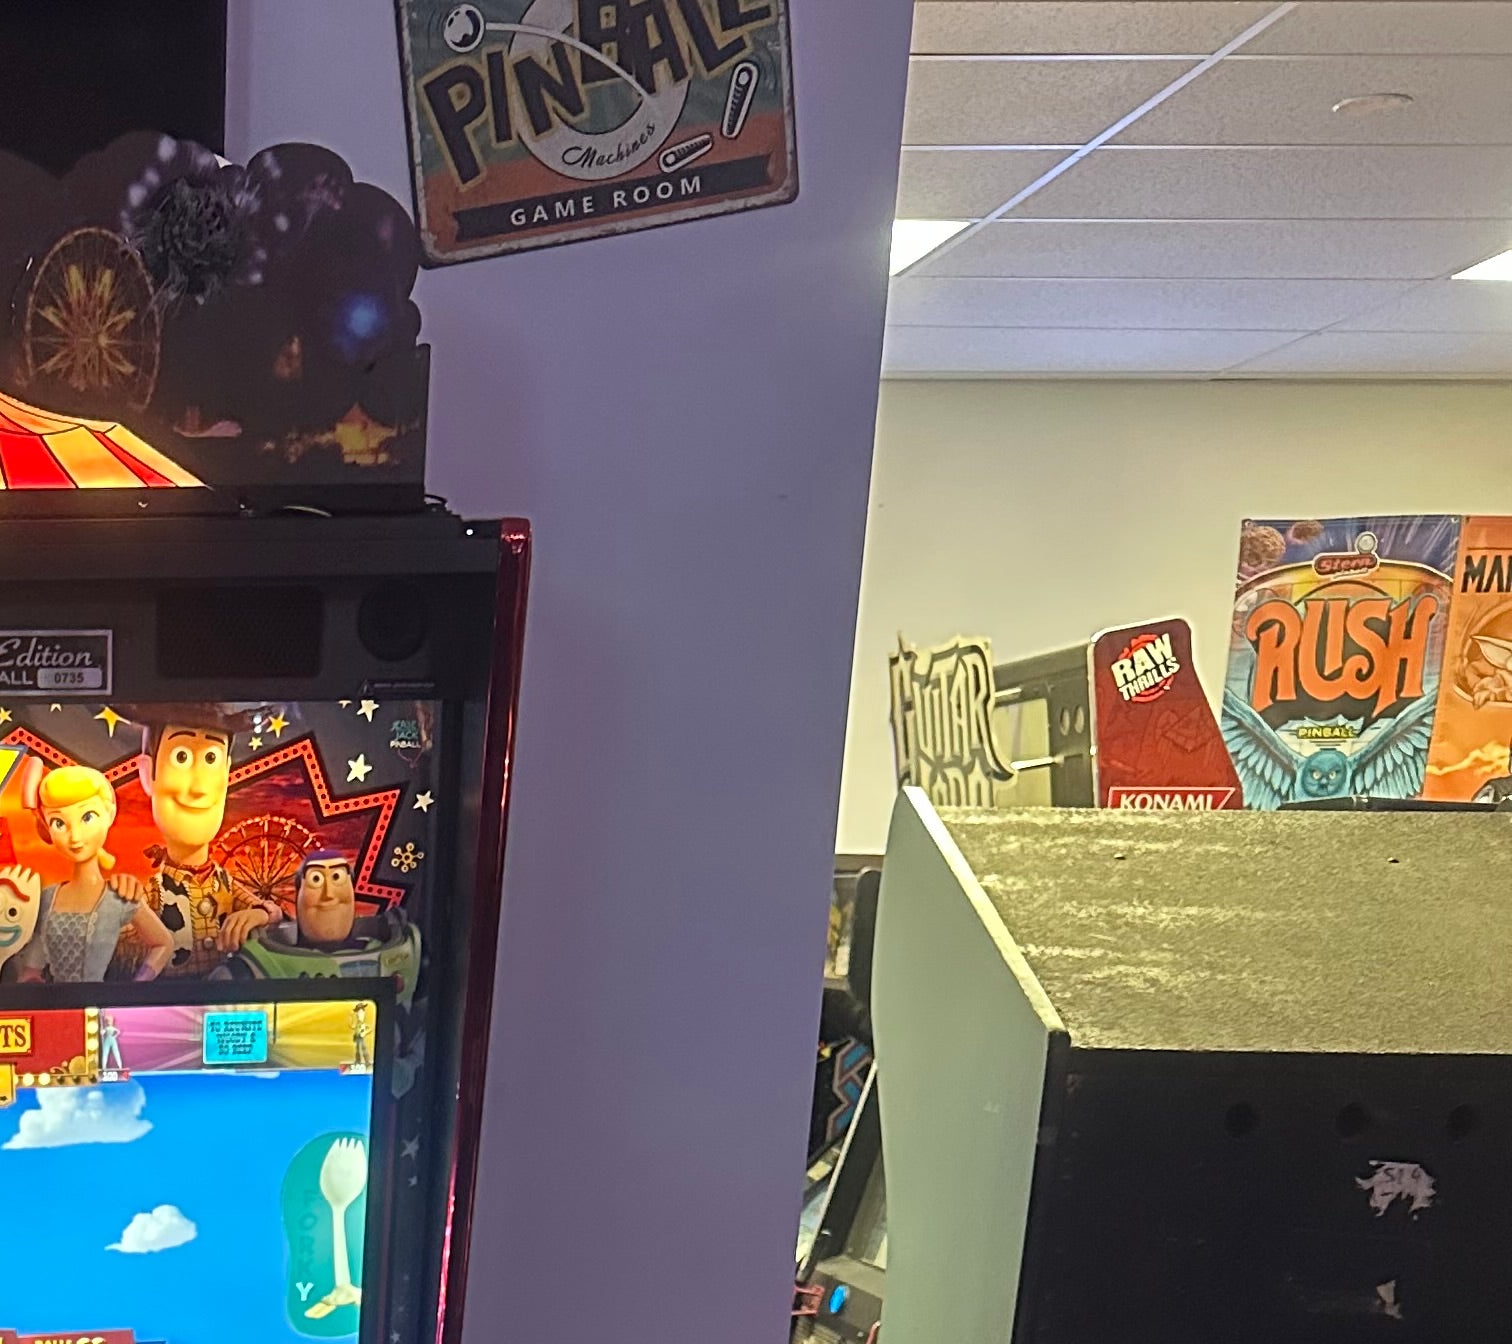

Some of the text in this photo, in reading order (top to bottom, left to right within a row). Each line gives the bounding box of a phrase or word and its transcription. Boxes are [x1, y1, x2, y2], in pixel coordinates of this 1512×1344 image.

[424, 0, 771, 184] PINBALL
[563, 121, 656, 168] Machines
[510, 175, 703, 227] GAME ROOM
[52, 672, 86, 685] 0735
[1111, 633, 1174, 688] RAW
[1118, 656, 1181, 701] THRILLS
[1246, 596, 1438, 718] RUSH
[1297, 727, 1356, 739] PINBALL
[1119, 793, 1213, 809] KONAMI
